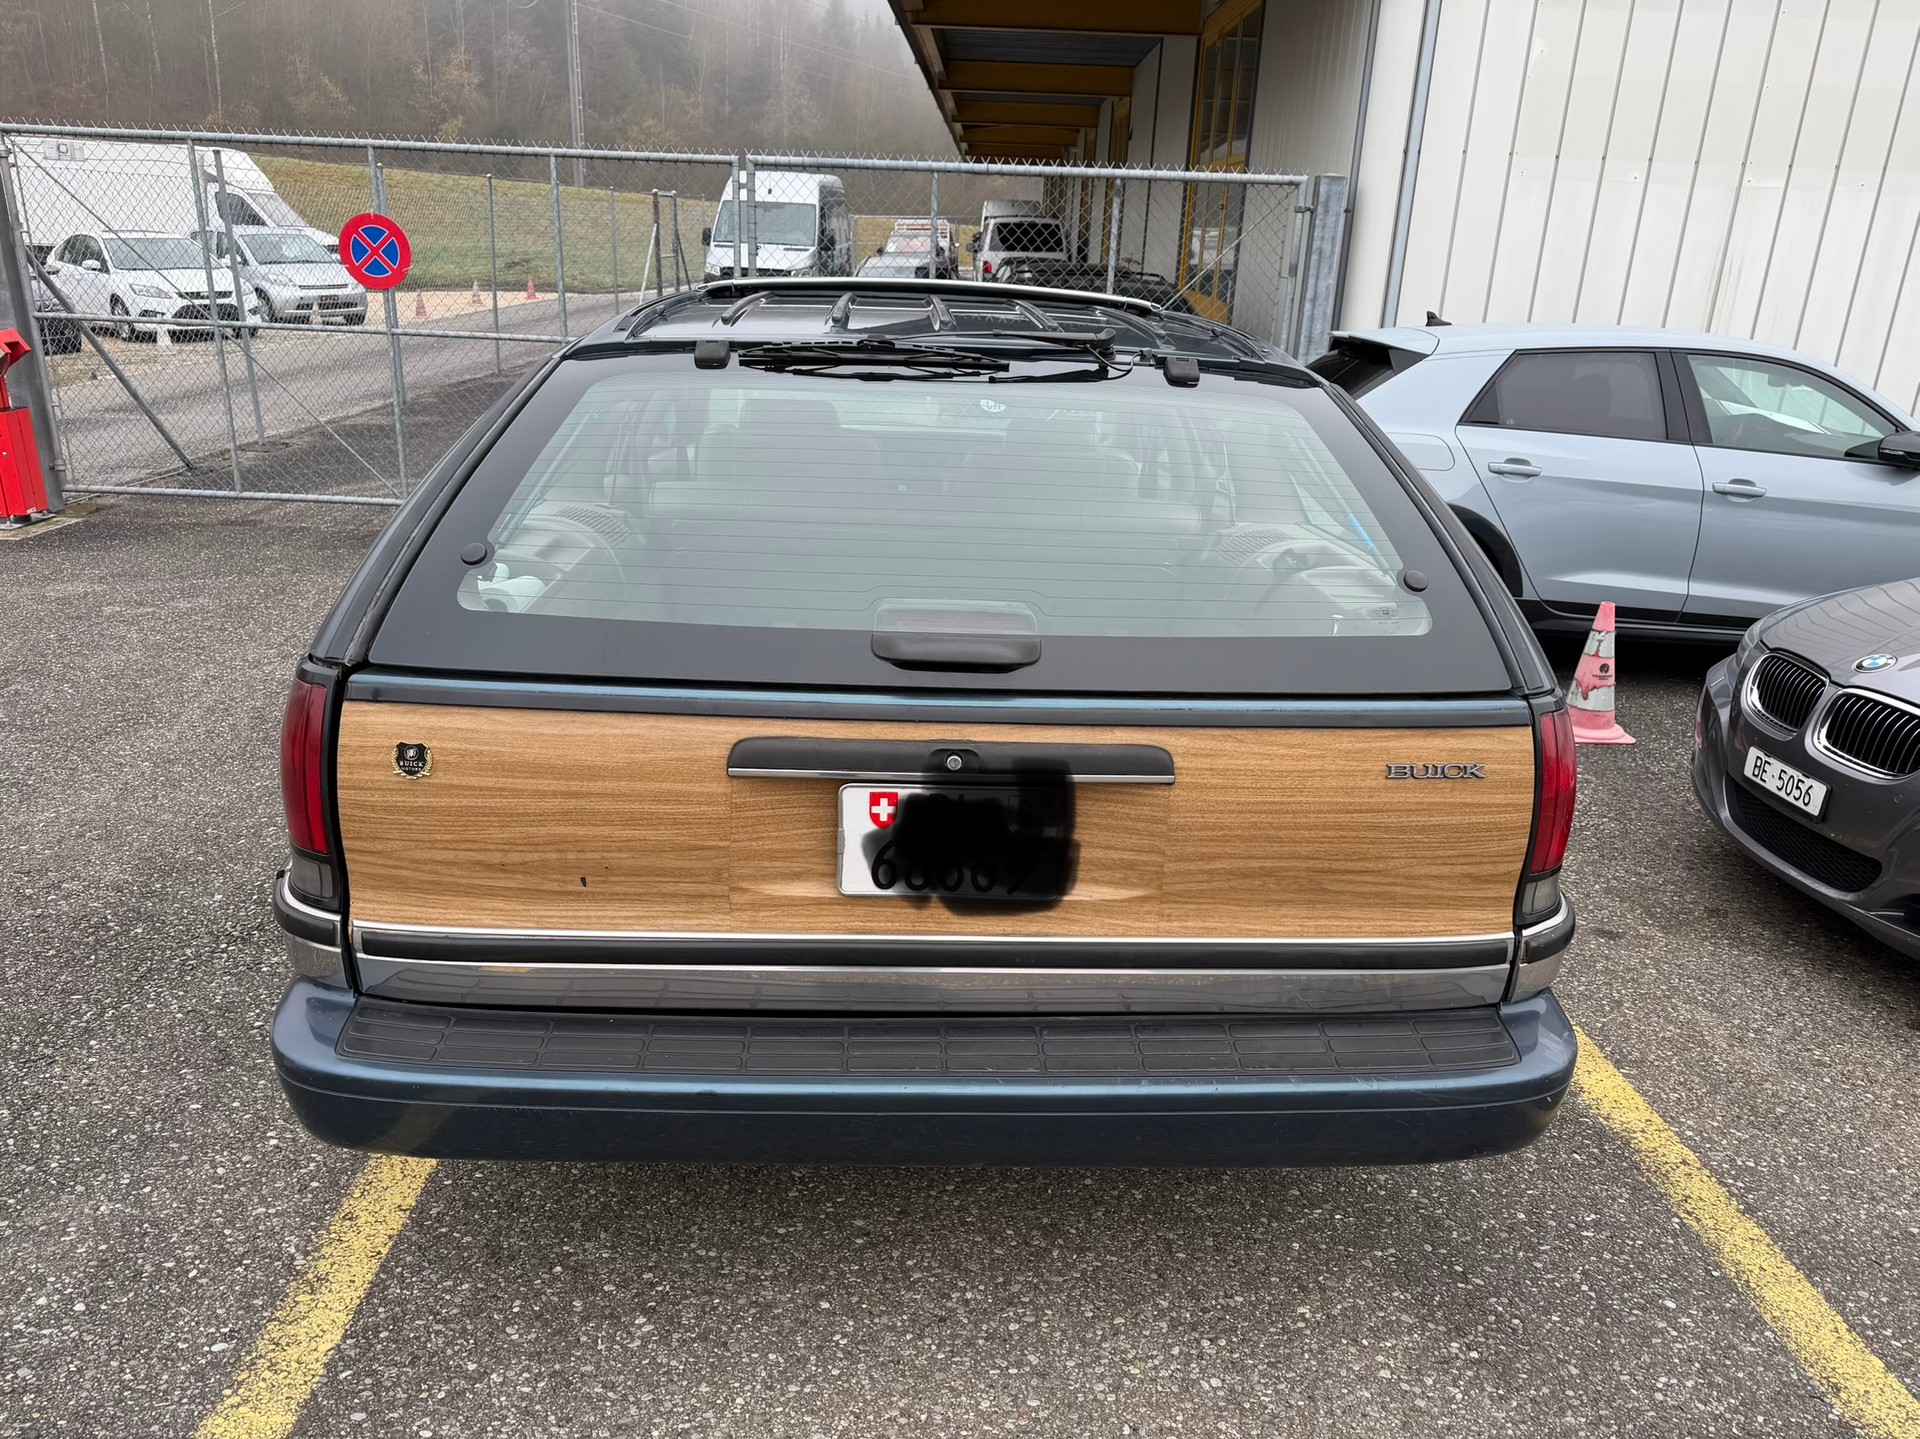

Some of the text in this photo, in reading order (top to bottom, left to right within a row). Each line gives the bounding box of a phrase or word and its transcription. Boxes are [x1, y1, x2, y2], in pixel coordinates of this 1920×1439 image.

[1386, 763, 1486, 779] BUICK
[1752, 755, 1814, 807] BE 5056
